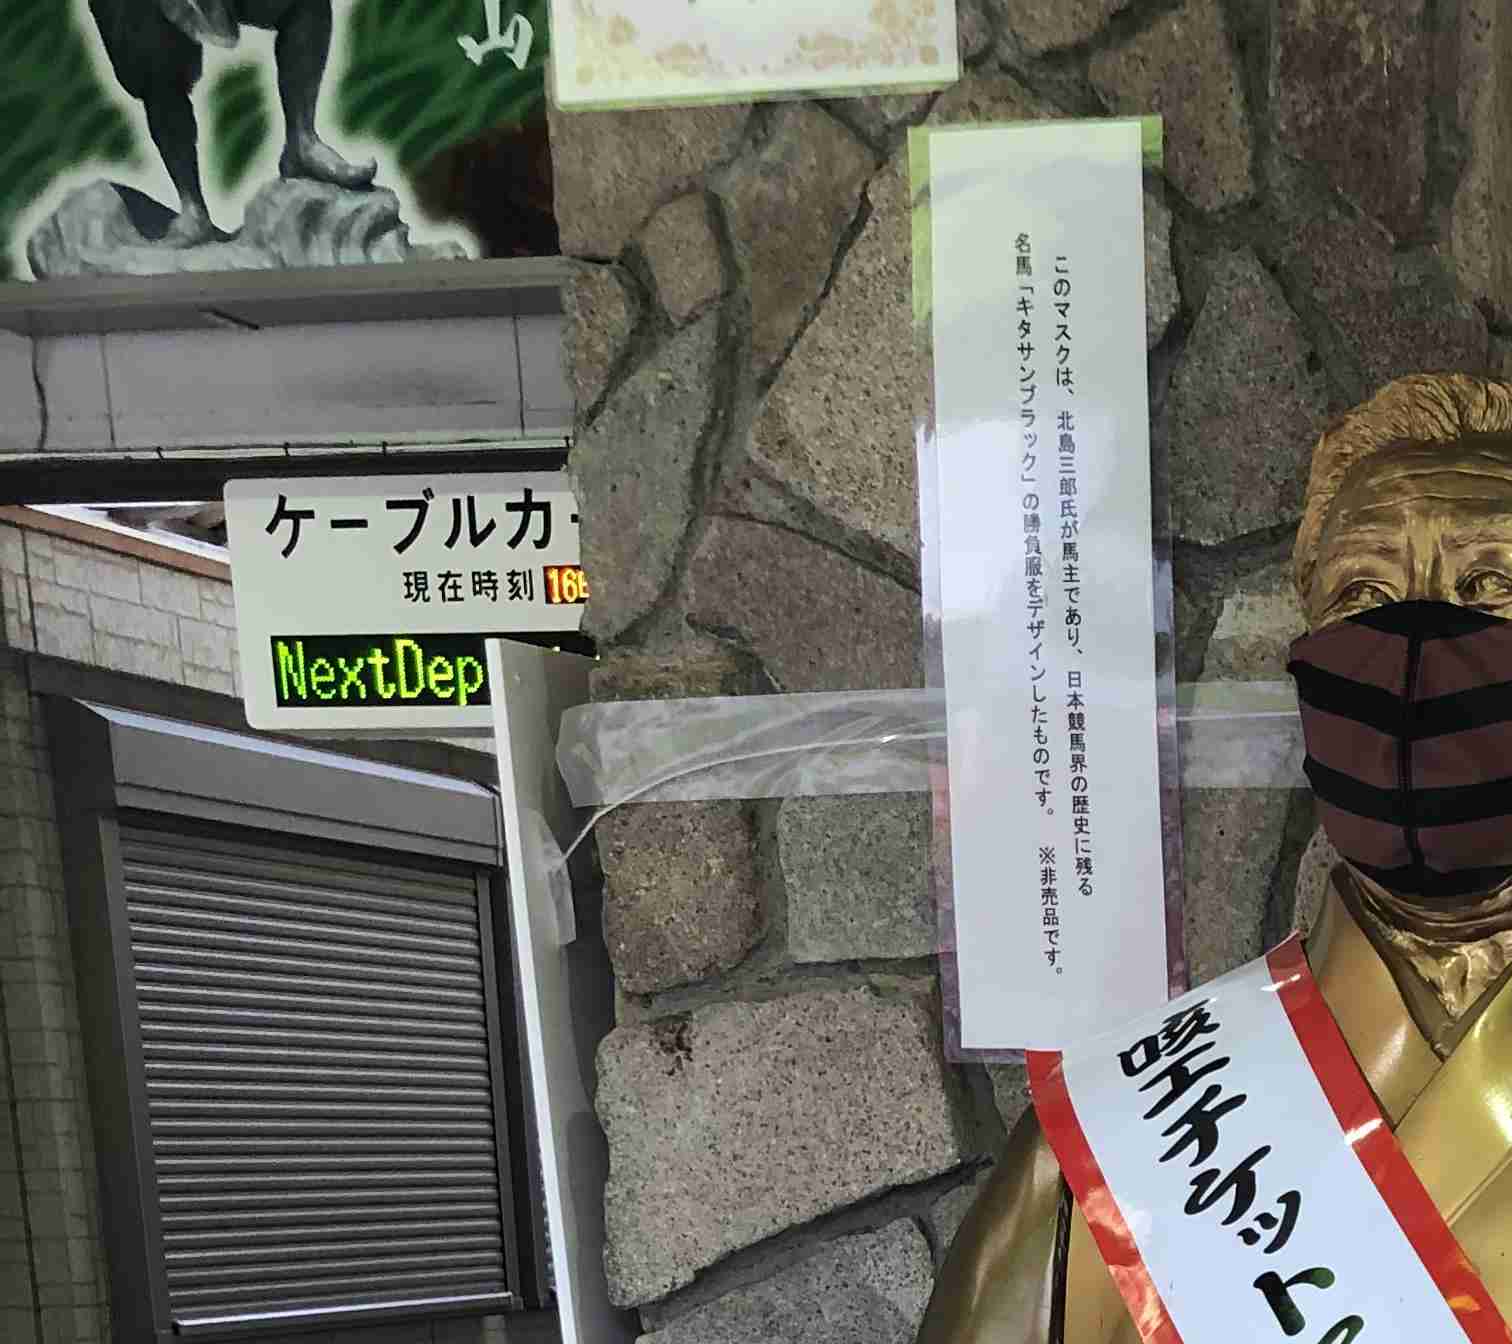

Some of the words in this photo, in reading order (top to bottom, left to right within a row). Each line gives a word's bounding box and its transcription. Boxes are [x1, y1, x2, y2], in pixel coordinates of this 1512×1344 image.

[265, 487, 579, 560] ケーブルカ
[402, 568, 535, 603] 現在時刻
[277, 636, 486, 707] NextDep
